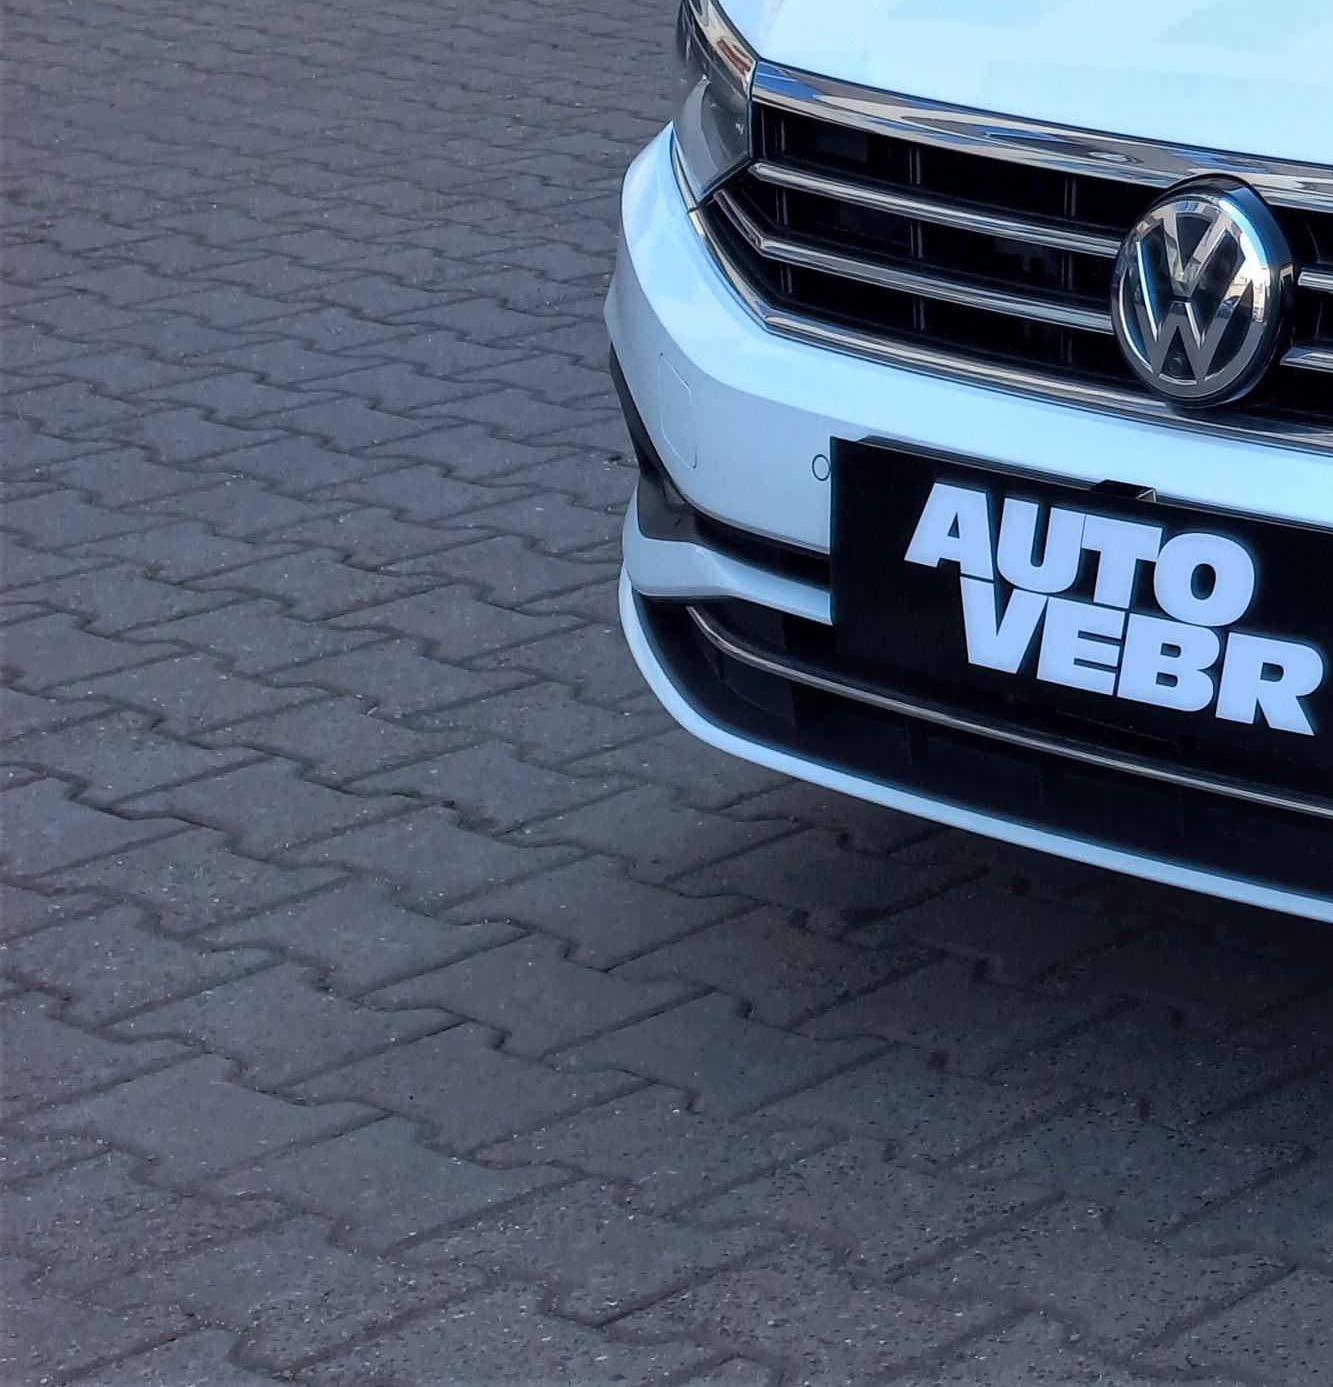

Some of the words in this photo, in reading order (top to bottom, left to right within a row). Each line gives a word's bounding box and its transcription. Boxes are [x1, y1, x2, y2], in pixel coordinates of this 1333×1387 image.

[1112, 197, 1271, 397] VW
[904, 482, 1256, 627] AUTO
[960, 576, 1325, 736] VEBR
